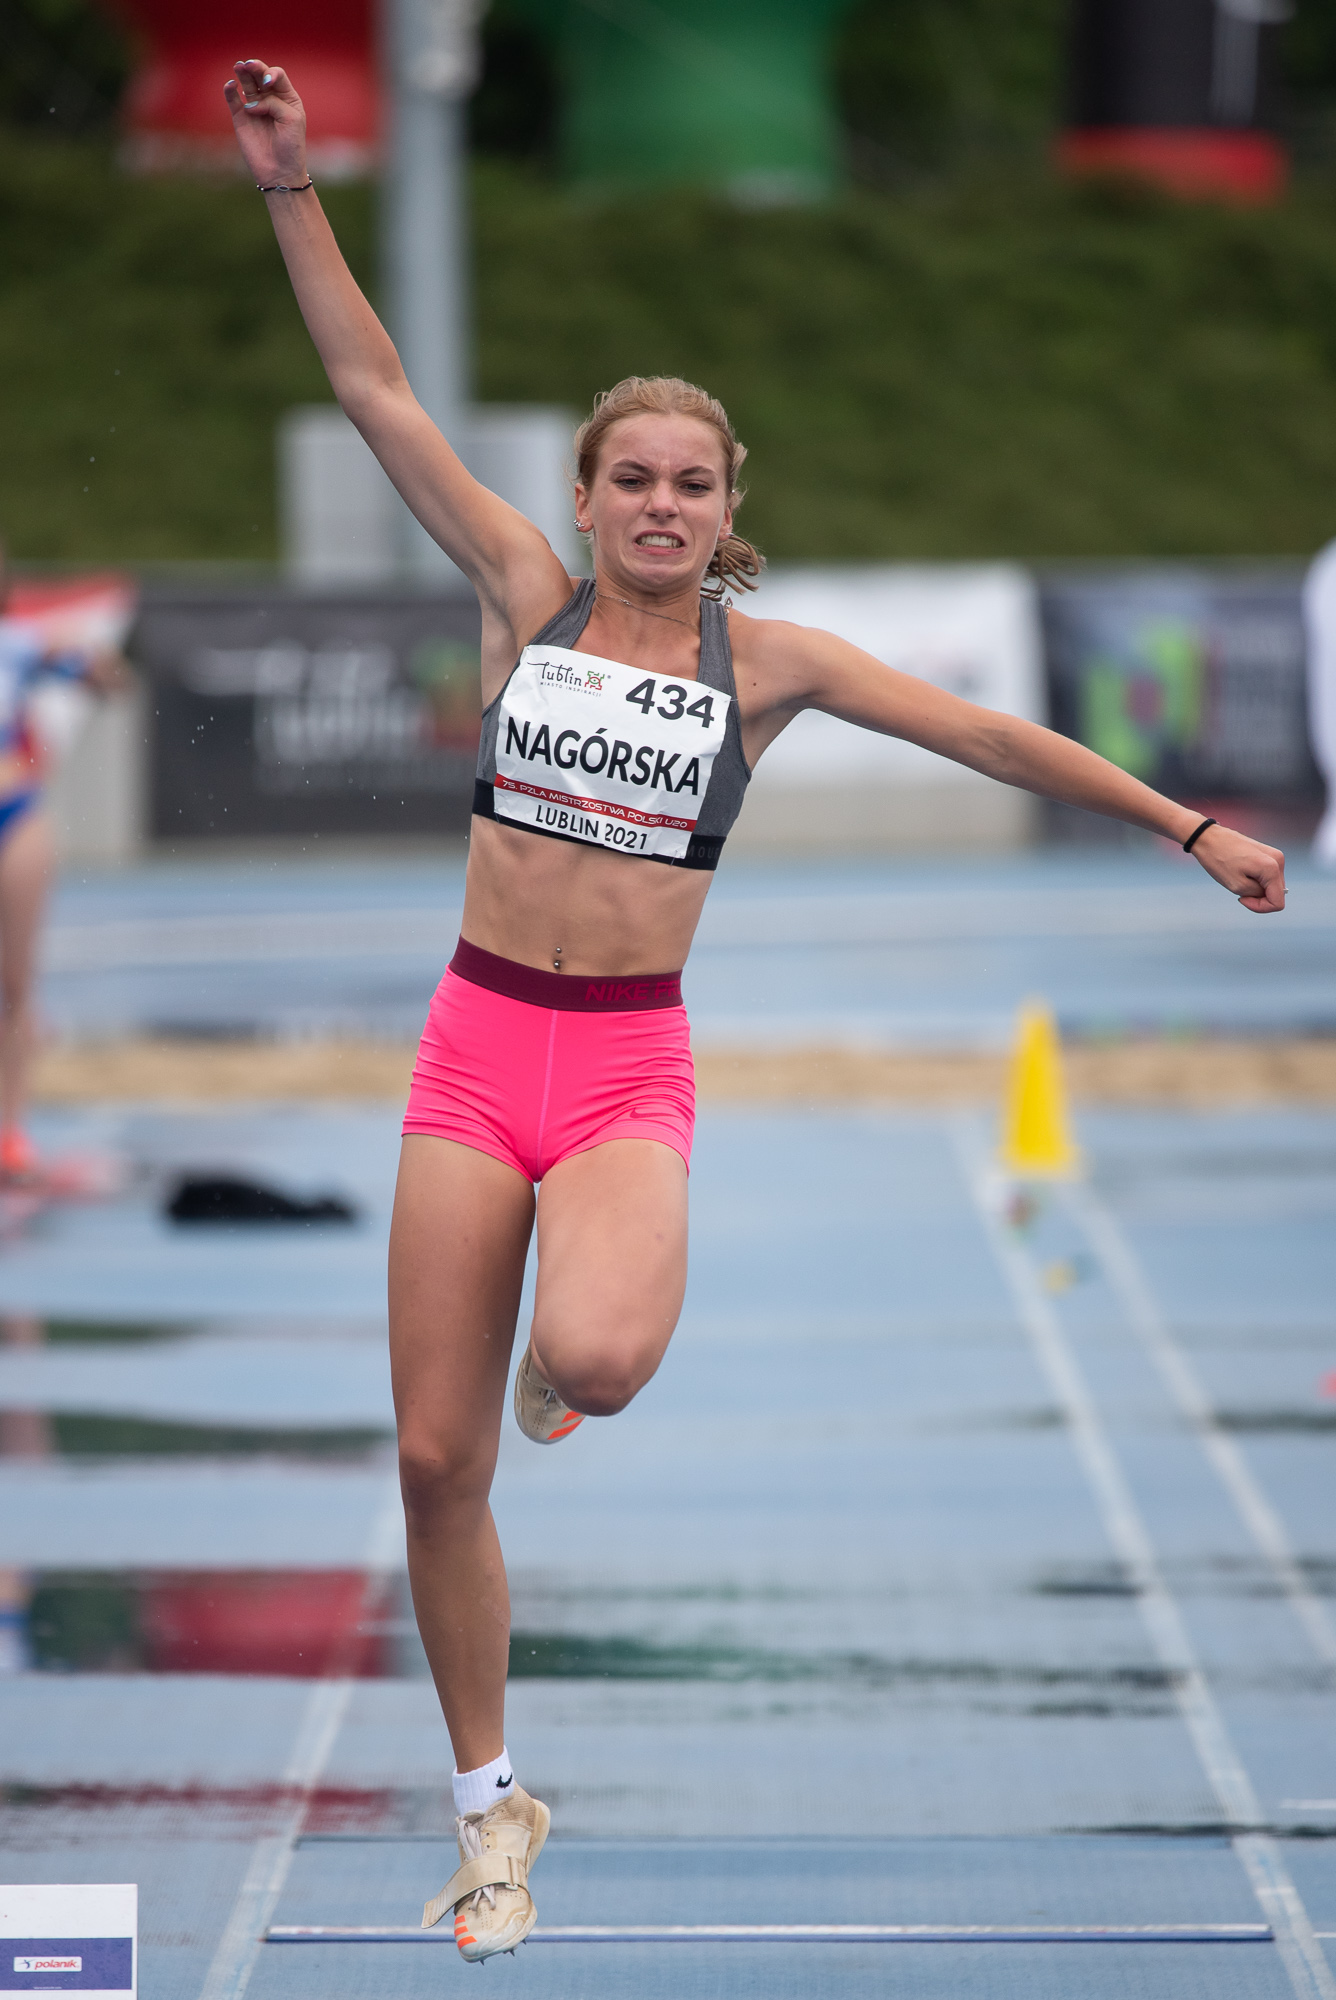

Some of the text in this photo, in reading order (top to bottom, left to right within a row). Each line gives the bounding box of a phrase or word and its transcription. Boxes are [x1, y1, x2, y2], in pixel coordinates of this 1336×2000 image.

[540, 681, 602, 697] MIASTO INSPIRACJI
[625, 678, 715, 729] 434
[505, 716, 699, 796] NAGÓRSKA
[502, 779, 688, 828] 75. PZLA MISTRZOSTWA POLSKI U20
[535, 804, 648, 850] LUBLIN 2021
[584, 983, 650, 1002] NIKE
[34, 1959, 78, 1970] polanik
